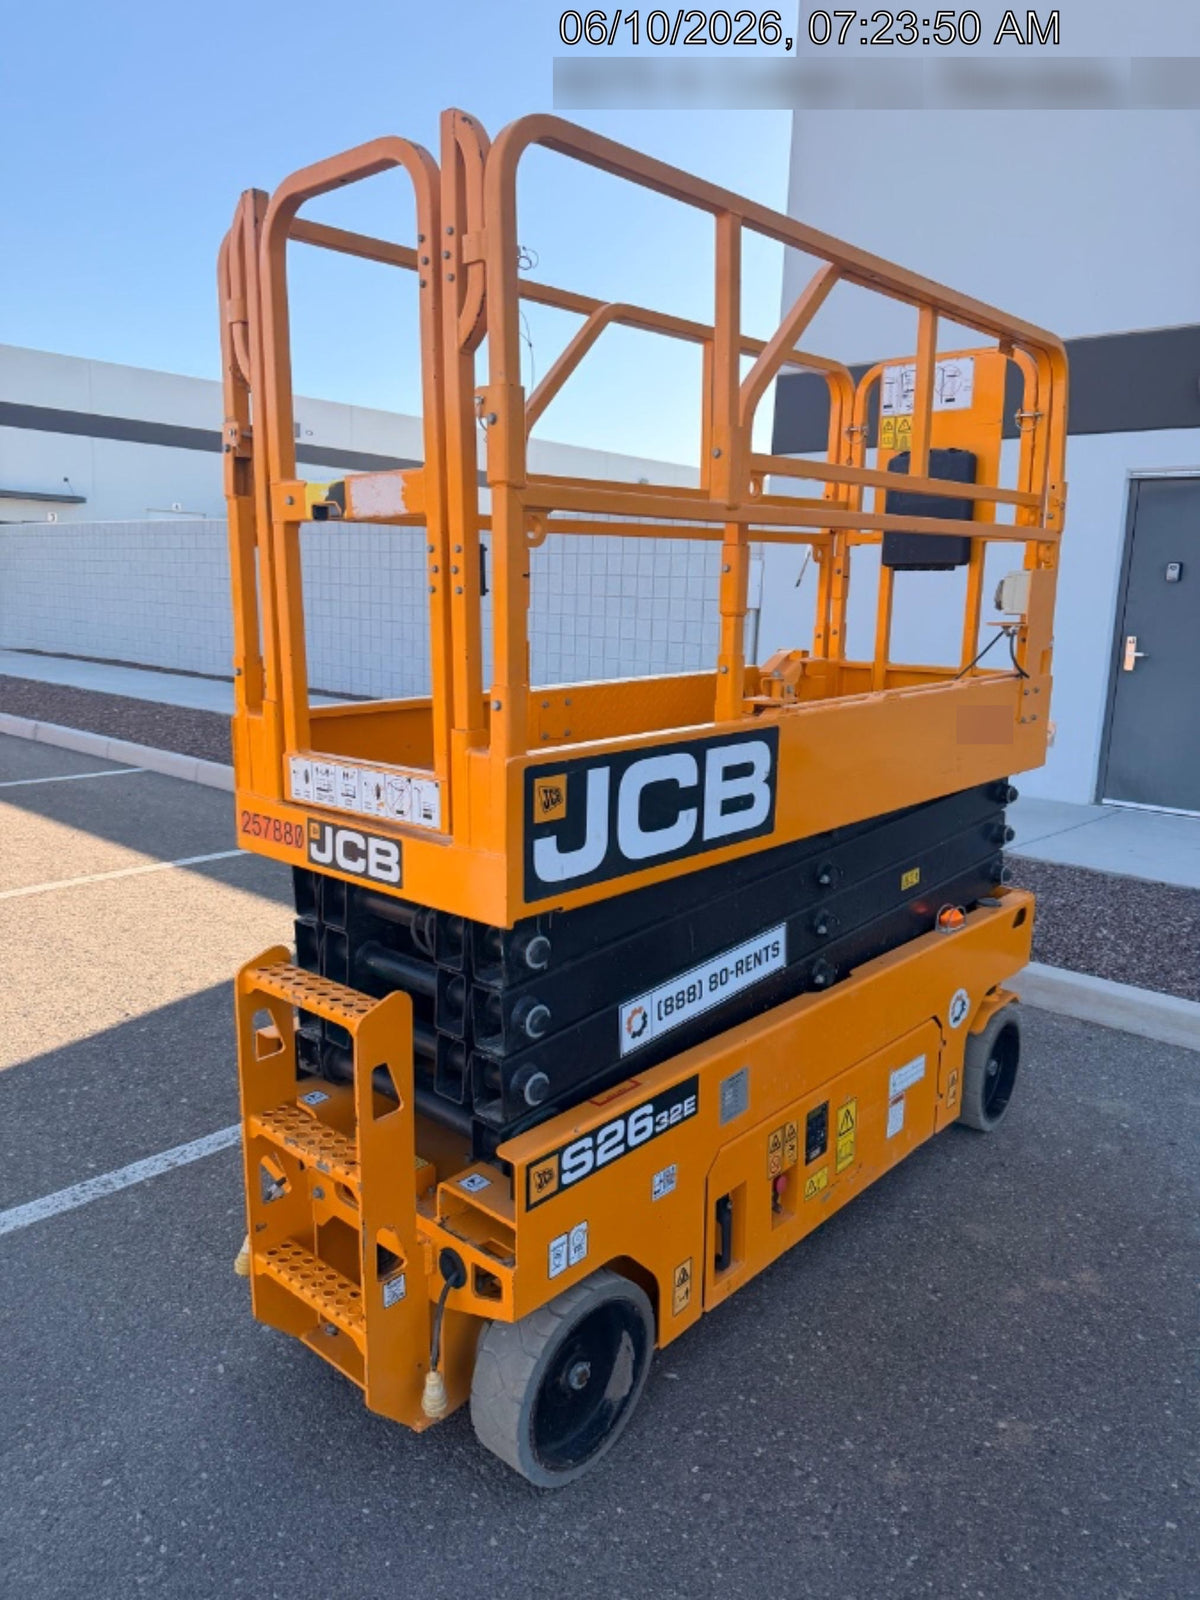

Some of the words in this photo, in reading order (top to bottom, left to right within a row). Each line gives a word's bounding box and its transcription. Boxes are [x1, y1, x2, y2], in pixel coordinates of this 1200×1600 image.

[533, 741, 771, 883] JCB
[538, 785, 563, 813] JCB
[310, 825, 401, 883] JCB
[656, 979, 704, 1021] (888)
[708, 940, 781, 993] 80-RENTS
